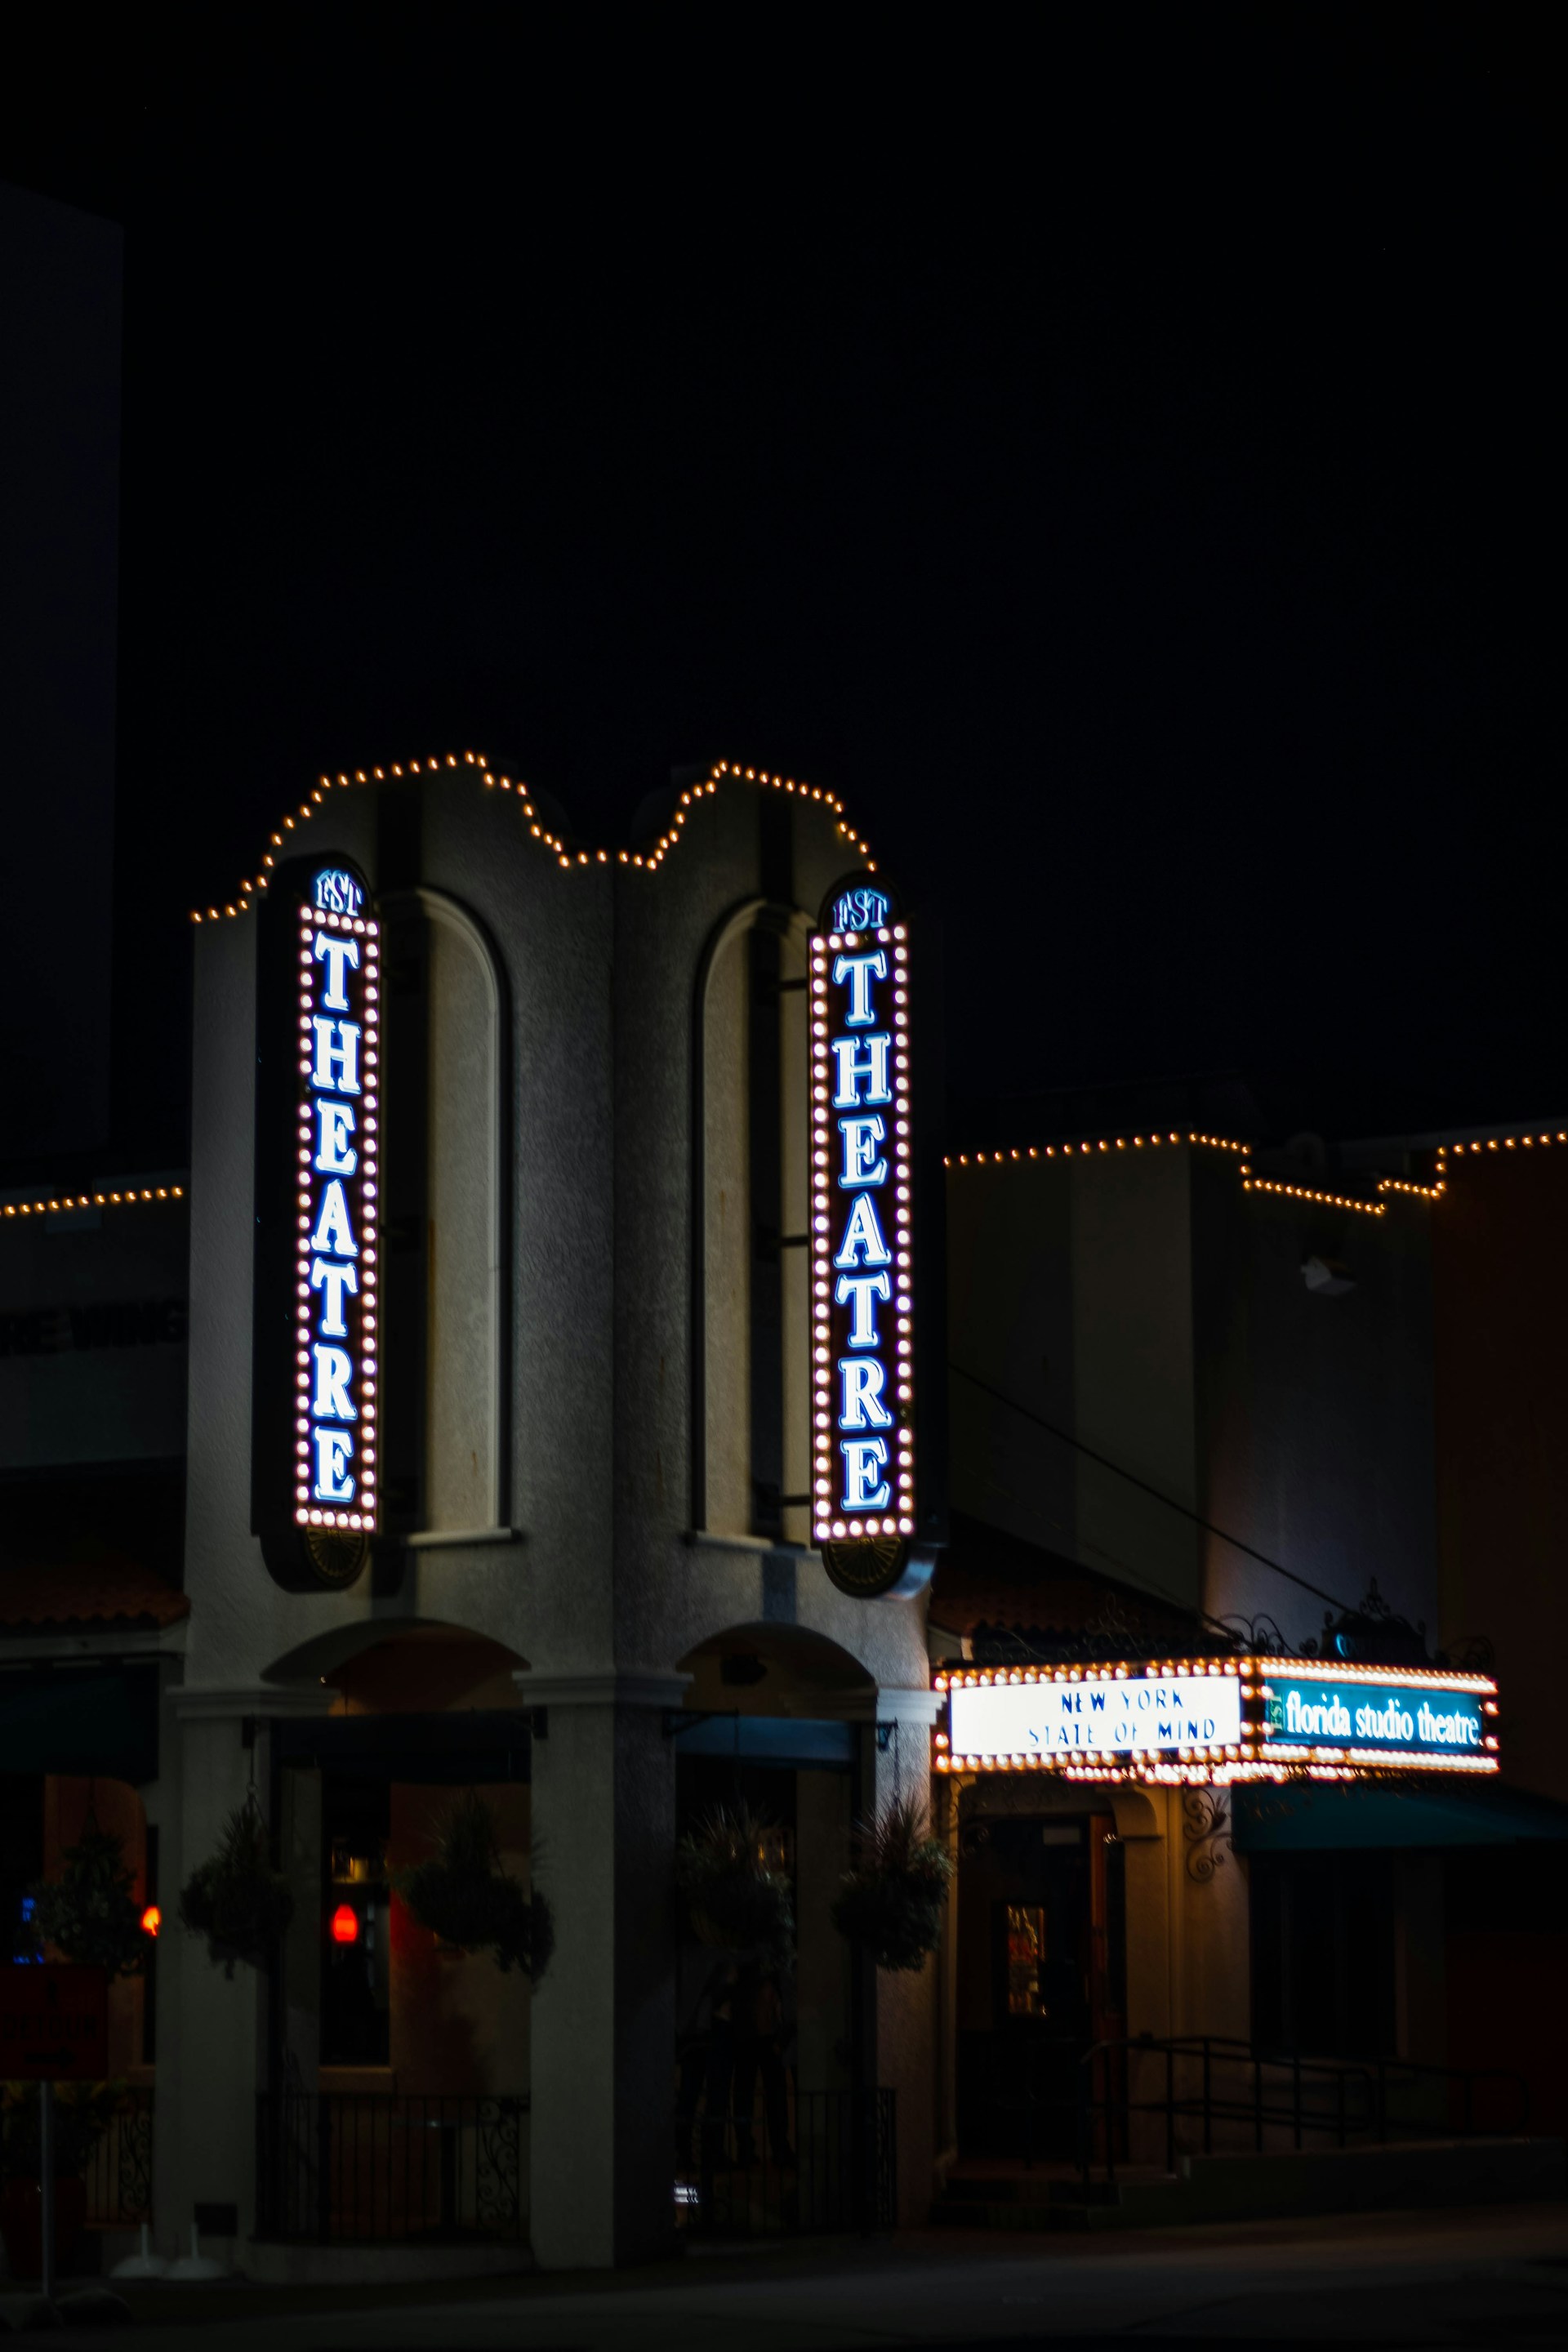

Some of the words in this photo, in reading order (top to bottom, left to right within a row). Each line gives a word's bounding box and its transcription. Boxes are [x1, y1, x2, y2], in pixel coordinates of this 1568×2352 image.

[315, 869, 363, 916] FST
[832, 888, 889, 933] FST
[311, 930, 361, 1503] THEATRE
[831, 950, 893, 1512] THEATRE
[68, 1299, 186, 1350] WING
[1061, 1691, 1107, 1713] NEW
[1121, 1688, 1184, 1711] YORK
[1285, 1690, 1352, 1737] florida
[1356, 1699, 1414, 1741] studio
[1417, 1701, 1479, 1745] theatre
[1029, 1723, 1096, 1747] STATE
[1115, 1722, 1138, 1743] OF
[1158, 1718, 1216, 1740] MIND
[2, 2011, 97, 2039] DETOUR
